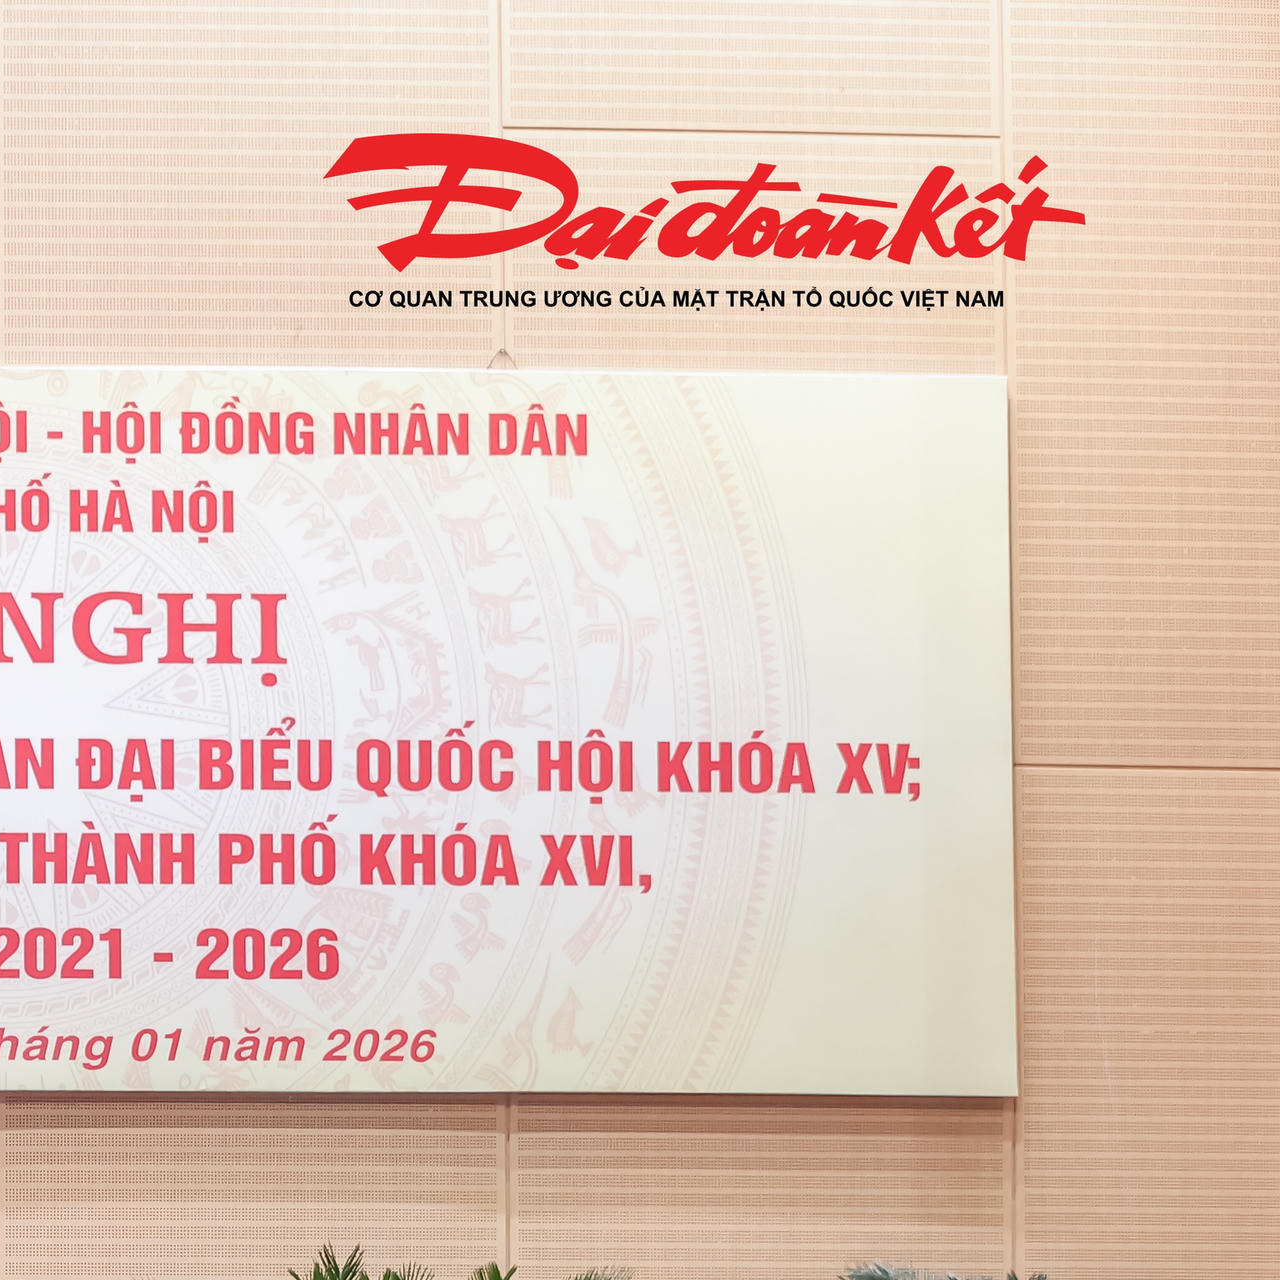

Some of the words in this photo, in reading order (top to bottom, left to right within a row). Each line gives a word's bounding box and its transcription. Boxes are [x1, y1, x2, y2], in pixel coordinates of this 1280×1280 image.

[47, 431, 63, 439] -
[82, 401, 161, 465] HỘI
[180, 396, 315, 456] ĐỒNG
[333, 403, 469, 456] NHÂN
[489, 403, 588, 457] DÂN
[69, 479, 134, 533] HÀ
[152, 480, 234, 545] NỘI
[76, 738, 175, 803] ĐẠI
[199, 718, 333, 792] BIỂU
[357, 720, 514, 798] QUỐC
[538, 729, 634, 805] HỘI
[658, 730, 815, 794] KHÓA
[837, 743, 921, 801] XV;
[219, 814, 337, 886] PHỐ
[360, 822, 519, 887] KHÓA
[541, 834, 652, 893] XVI,
[154, 952, 173, 963] -
[195, 927, 340, 981] 2026
[132, 1028, 182, 1062] 01
[203, 1031, 305, 1062] năm
[323, 1029, 436, 1063] 2026
